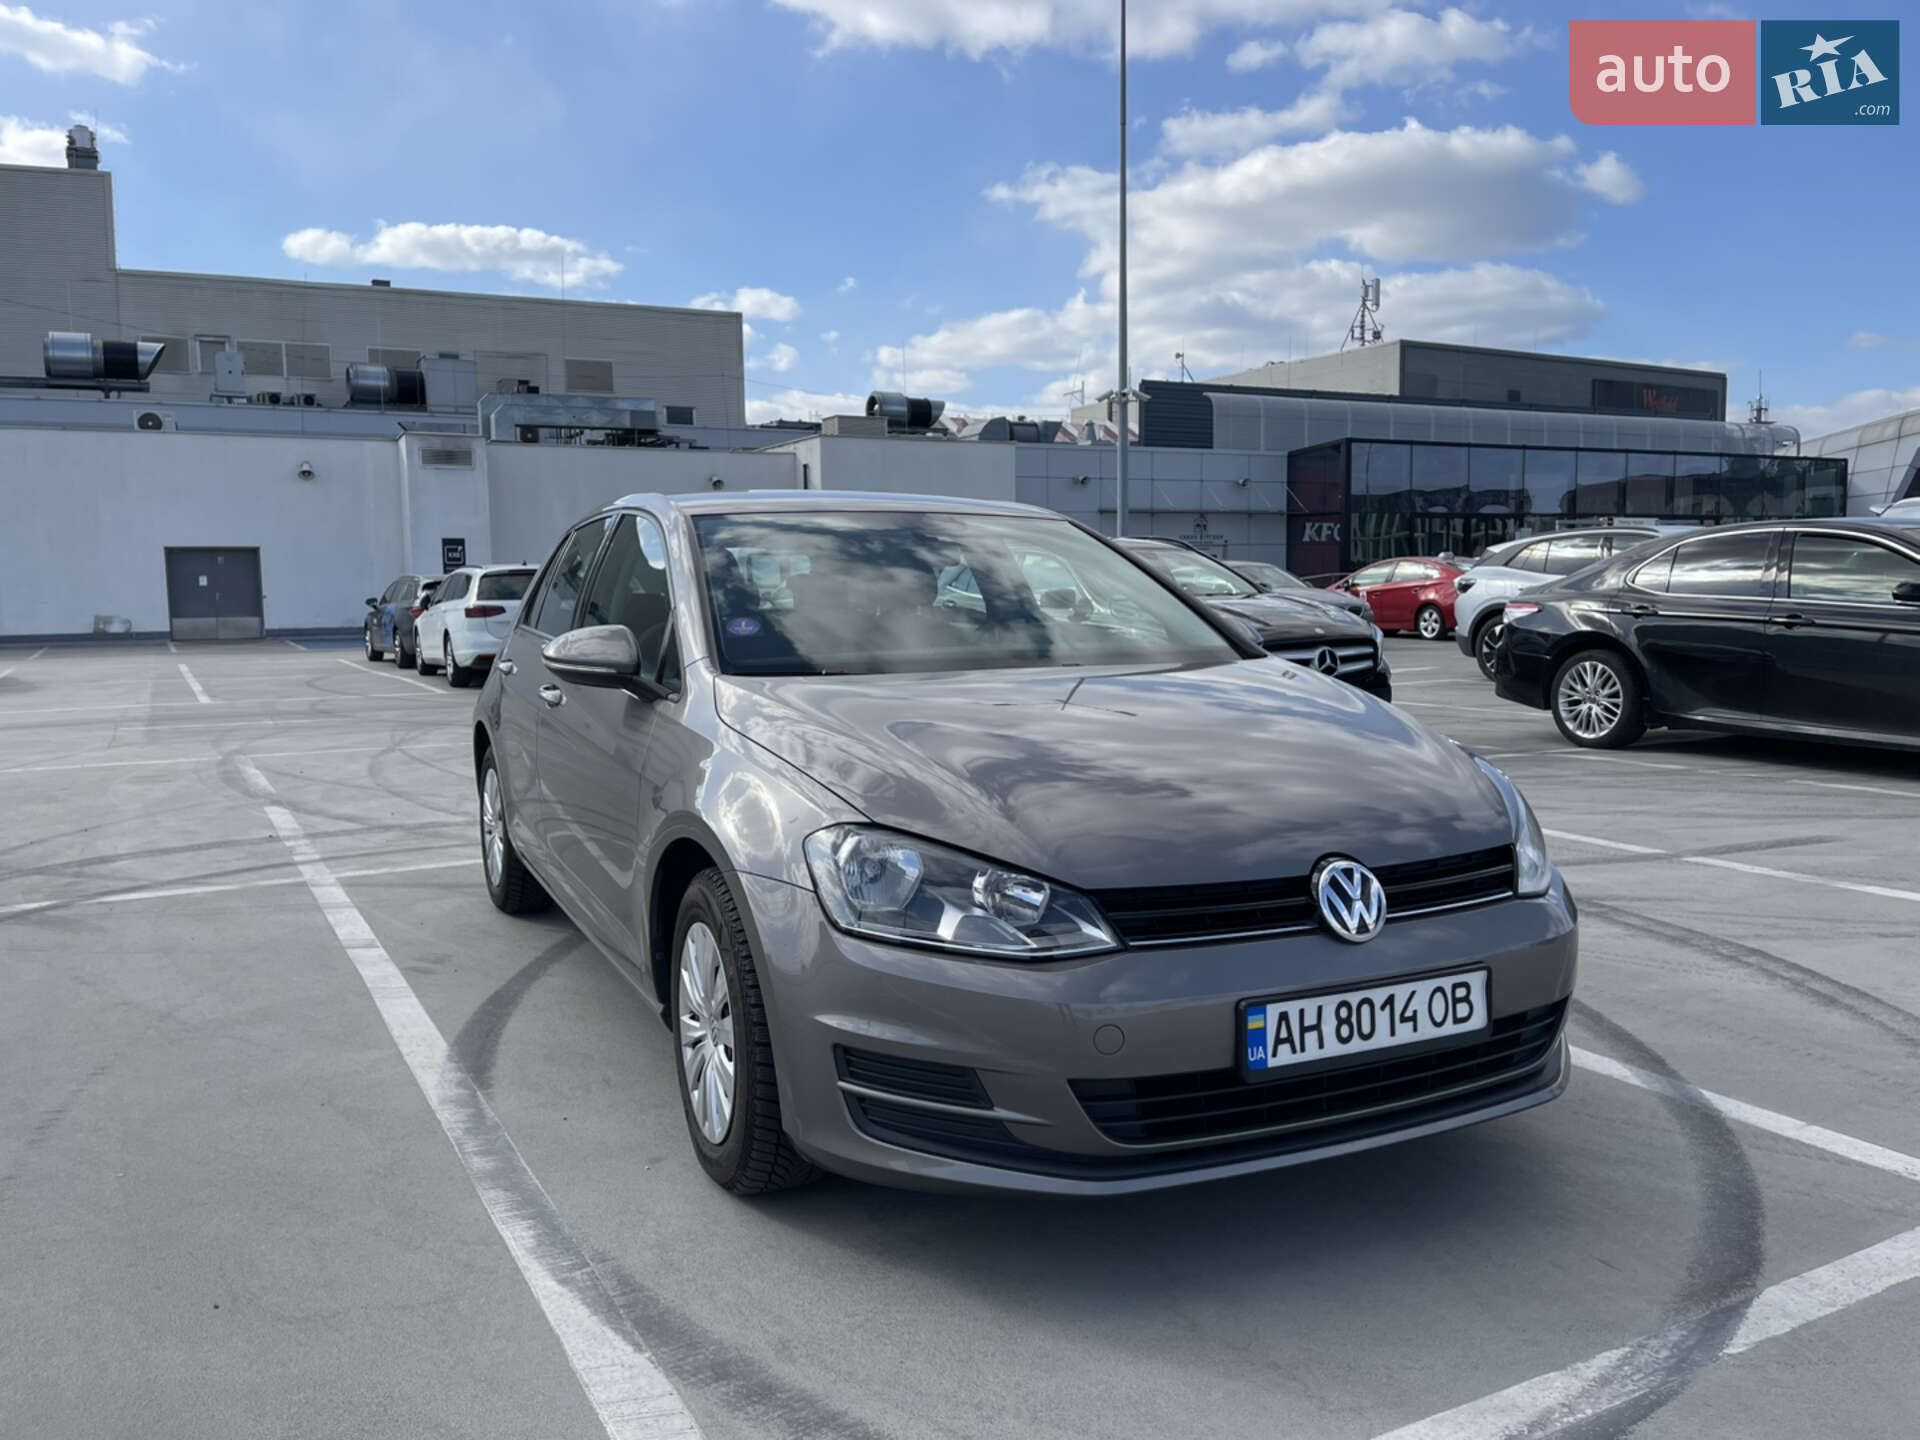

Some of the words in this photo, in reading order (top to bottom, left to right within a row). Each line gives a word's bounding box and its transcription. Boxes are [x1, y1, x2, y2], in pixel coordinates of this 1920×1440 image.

[1271, 1004, 1325, 1058] AH
[1334, 990, 1418, 1045] 8014
[1428, 981, 1474, 1029] OB
[1247, 1045, 1266, 1062] UA
